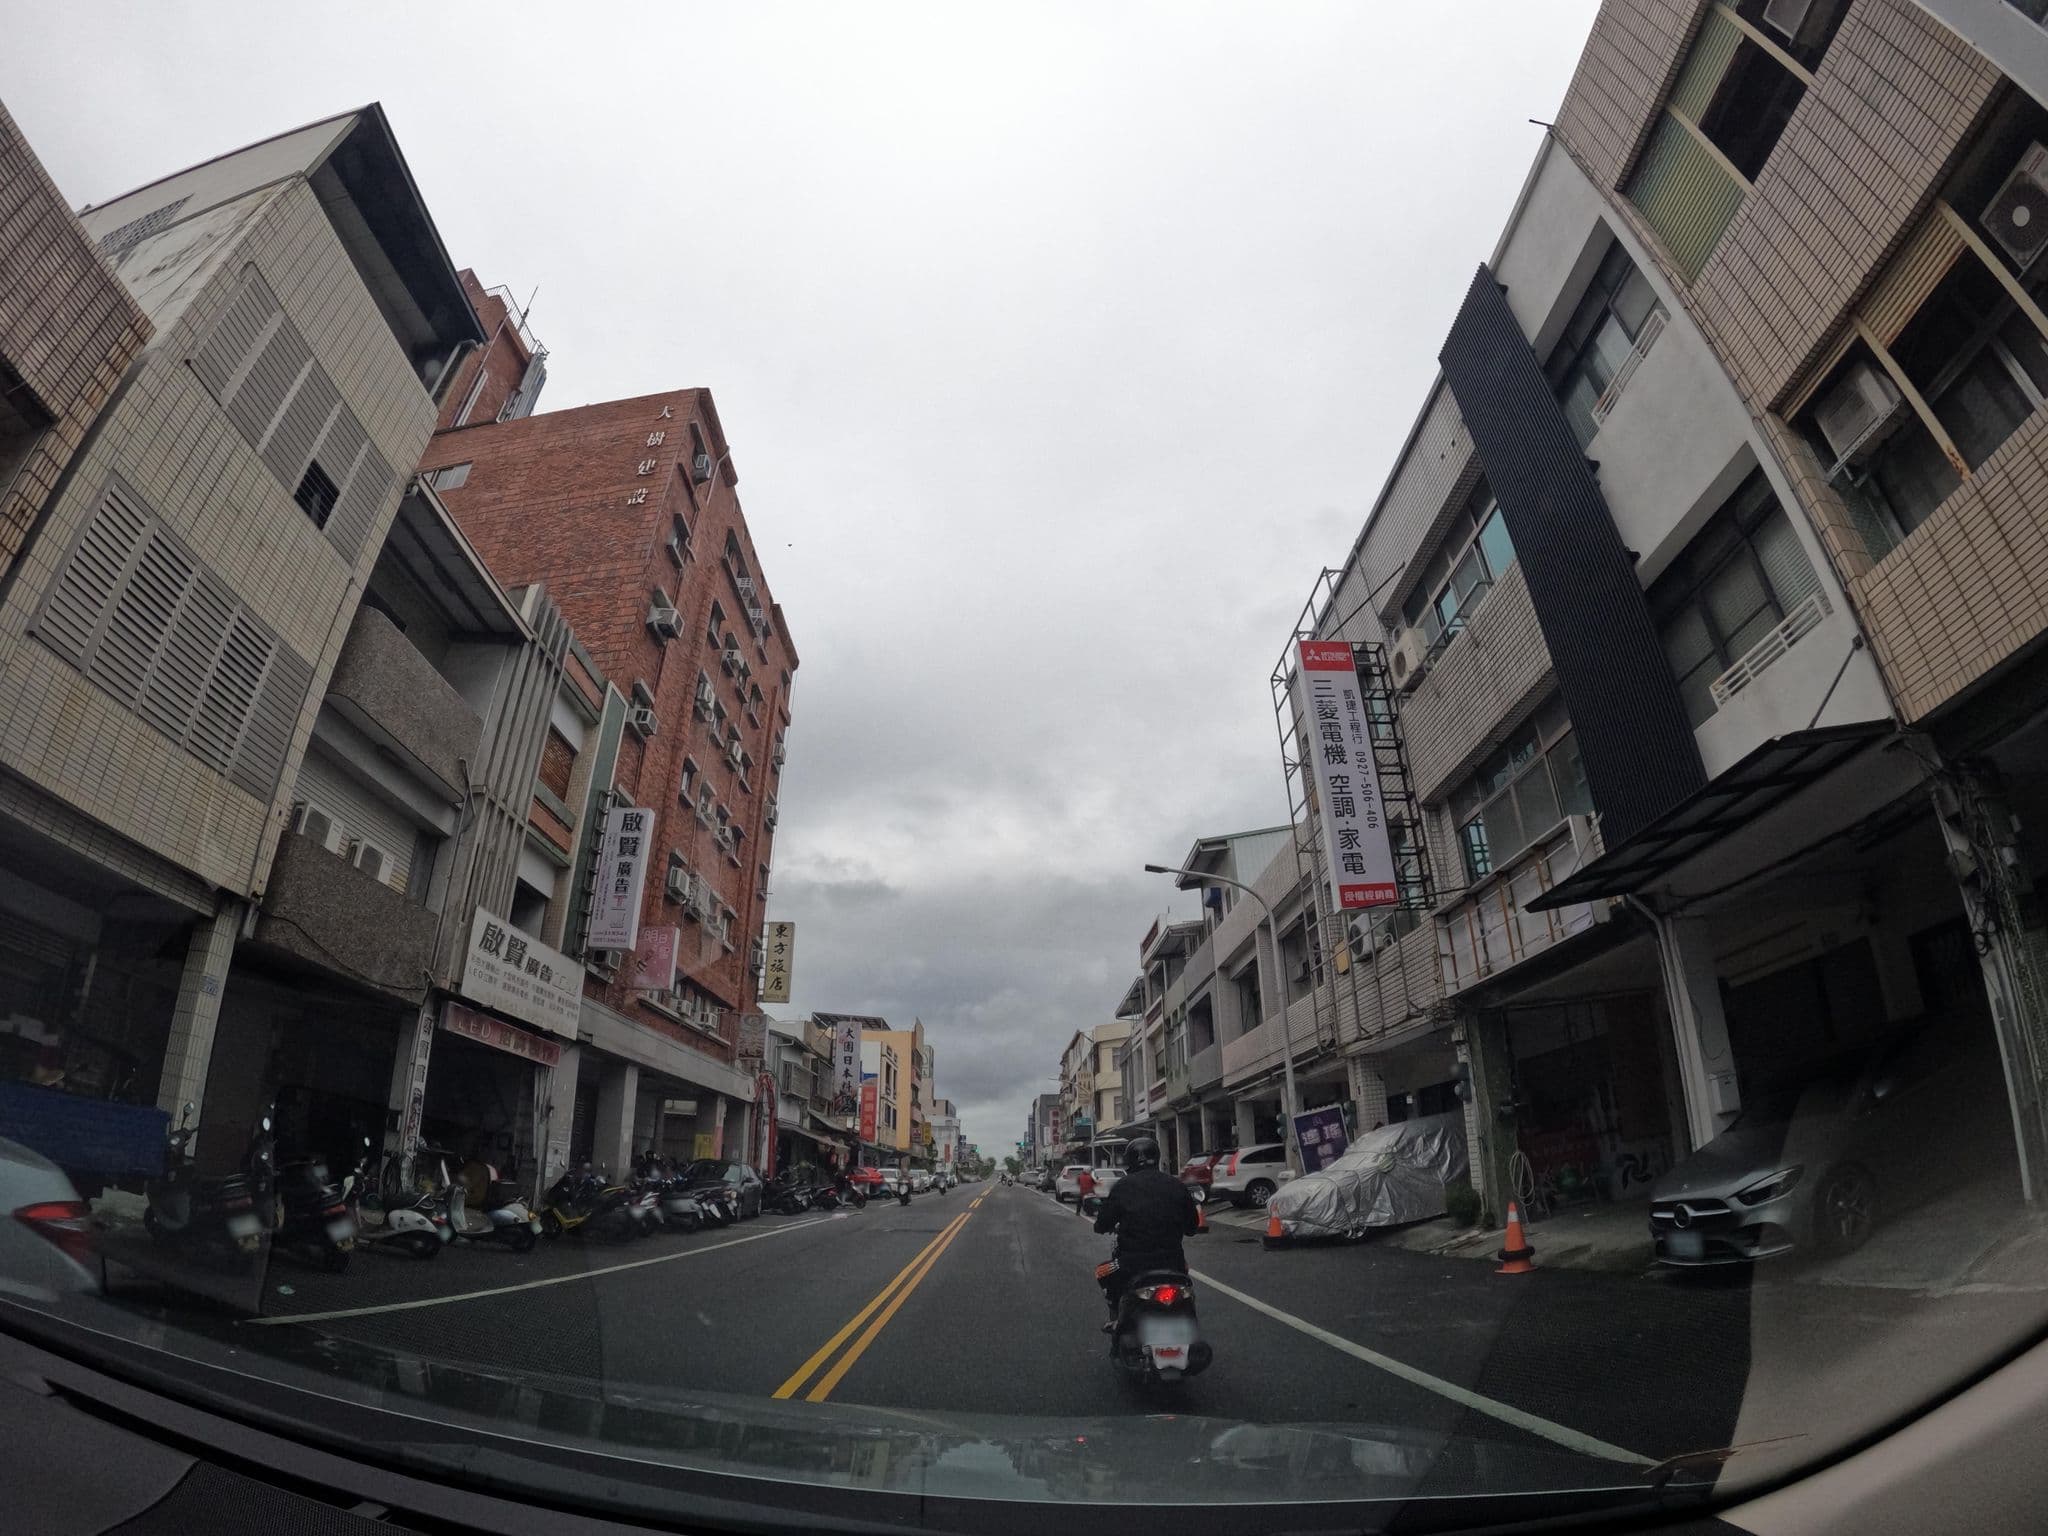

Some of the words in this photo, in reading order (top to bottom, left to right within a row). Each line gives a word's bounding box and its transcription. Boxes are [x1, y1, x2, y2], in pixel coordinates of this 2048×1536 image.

[1313, 679, 1348, 766] 三菱電機
[1355, 751, 1379, 829] 0927-506-406
[769, 924, 789, 991] 東方旅店
